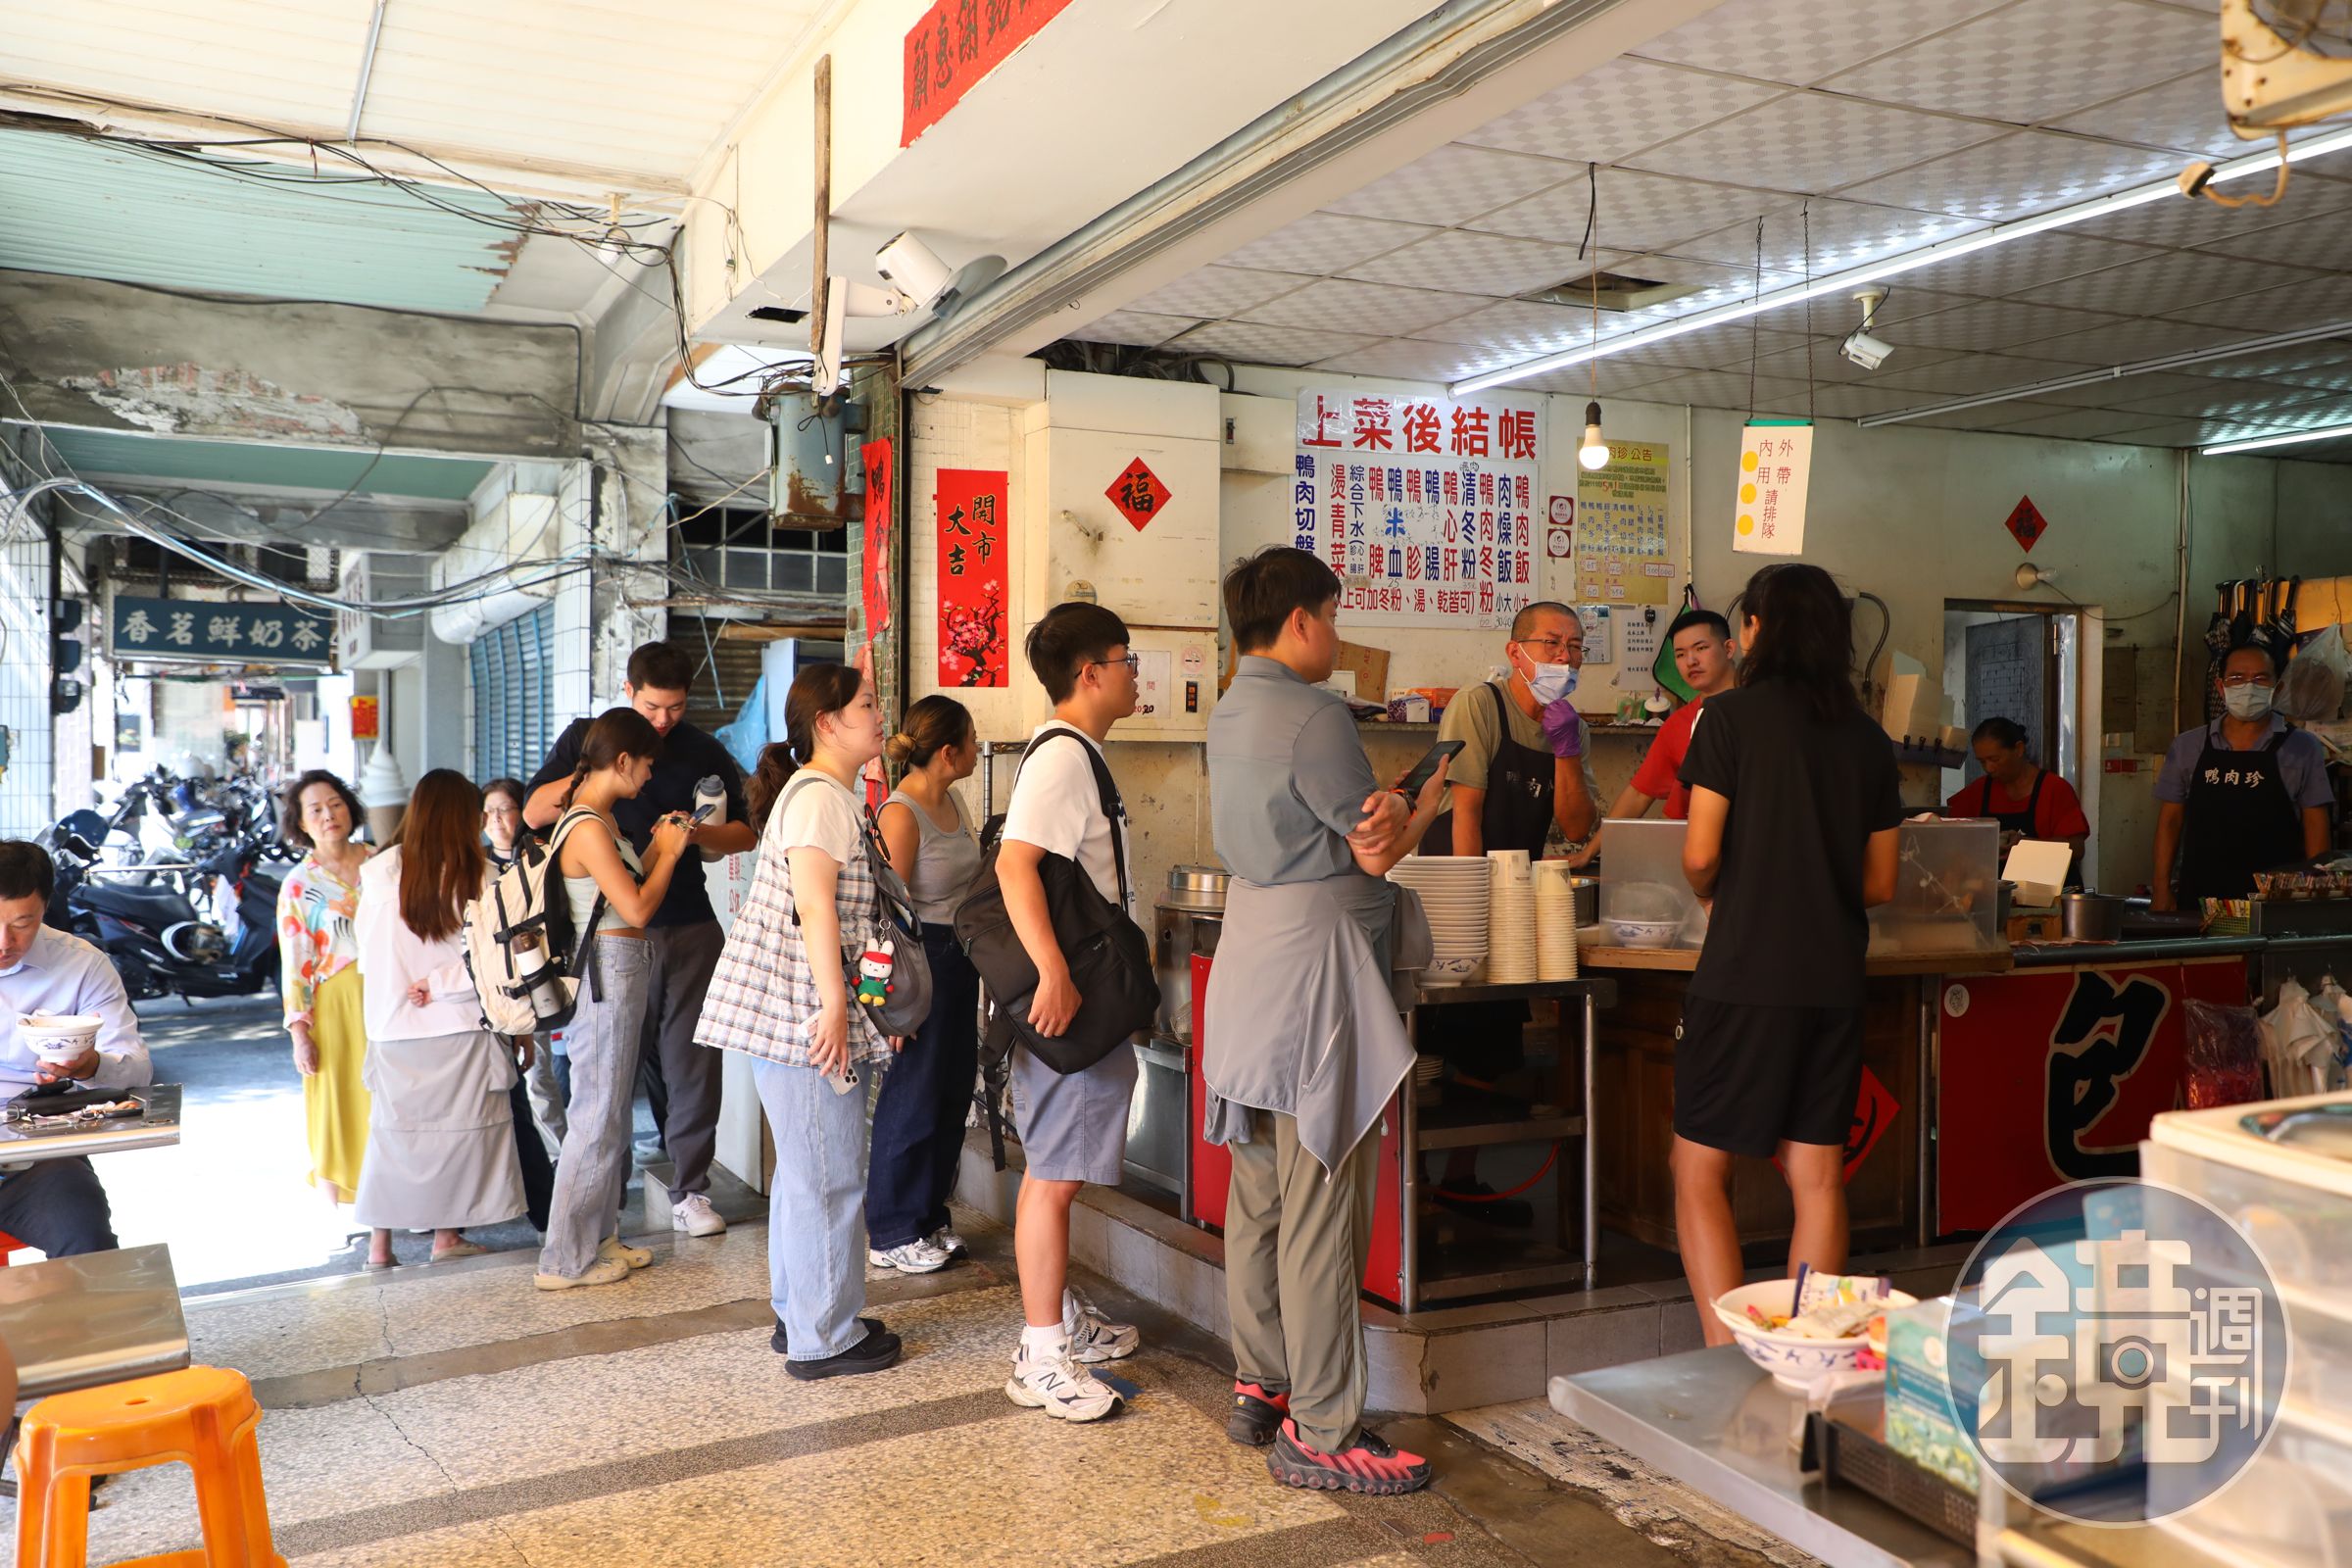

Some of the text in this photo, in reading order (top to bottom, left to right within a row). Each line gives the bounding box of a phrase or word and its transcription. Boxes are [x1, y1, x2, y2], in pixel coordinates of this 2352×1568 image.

[1301, 395, 1537, 461] 上菜後結帳
[1608, 446, 1652, 462] 肉珍公告
[1756, 439, 1773, 484] 內用
[1777, 439, 1793, 484] 外帶
[1120, 471, 1154, 513] 福
[1331, 464, 1347, 577] 燙青菜
[1385, 466, 1406, 578] 鴨米血
[1444, 470, 1458, 582] 鴨心肝
[1461, 471, 1476, 579] 清冬粉
[1762, 489, 1779, 539] 請排隊
[945, 504, 972, 575] 大吉
[972, 494, 997, 565] 開市
[1479, 472, 1494, 612] 鴨肉冬粉
[1497, 472, 1512, 584] 肉燥飯
[1515, 474, 1530, 584] 鴨肉飯
[122, 610, 324, 652] 香茗鮮奶茶
[2204, 767, 2265, 788] 鴨肉珍
